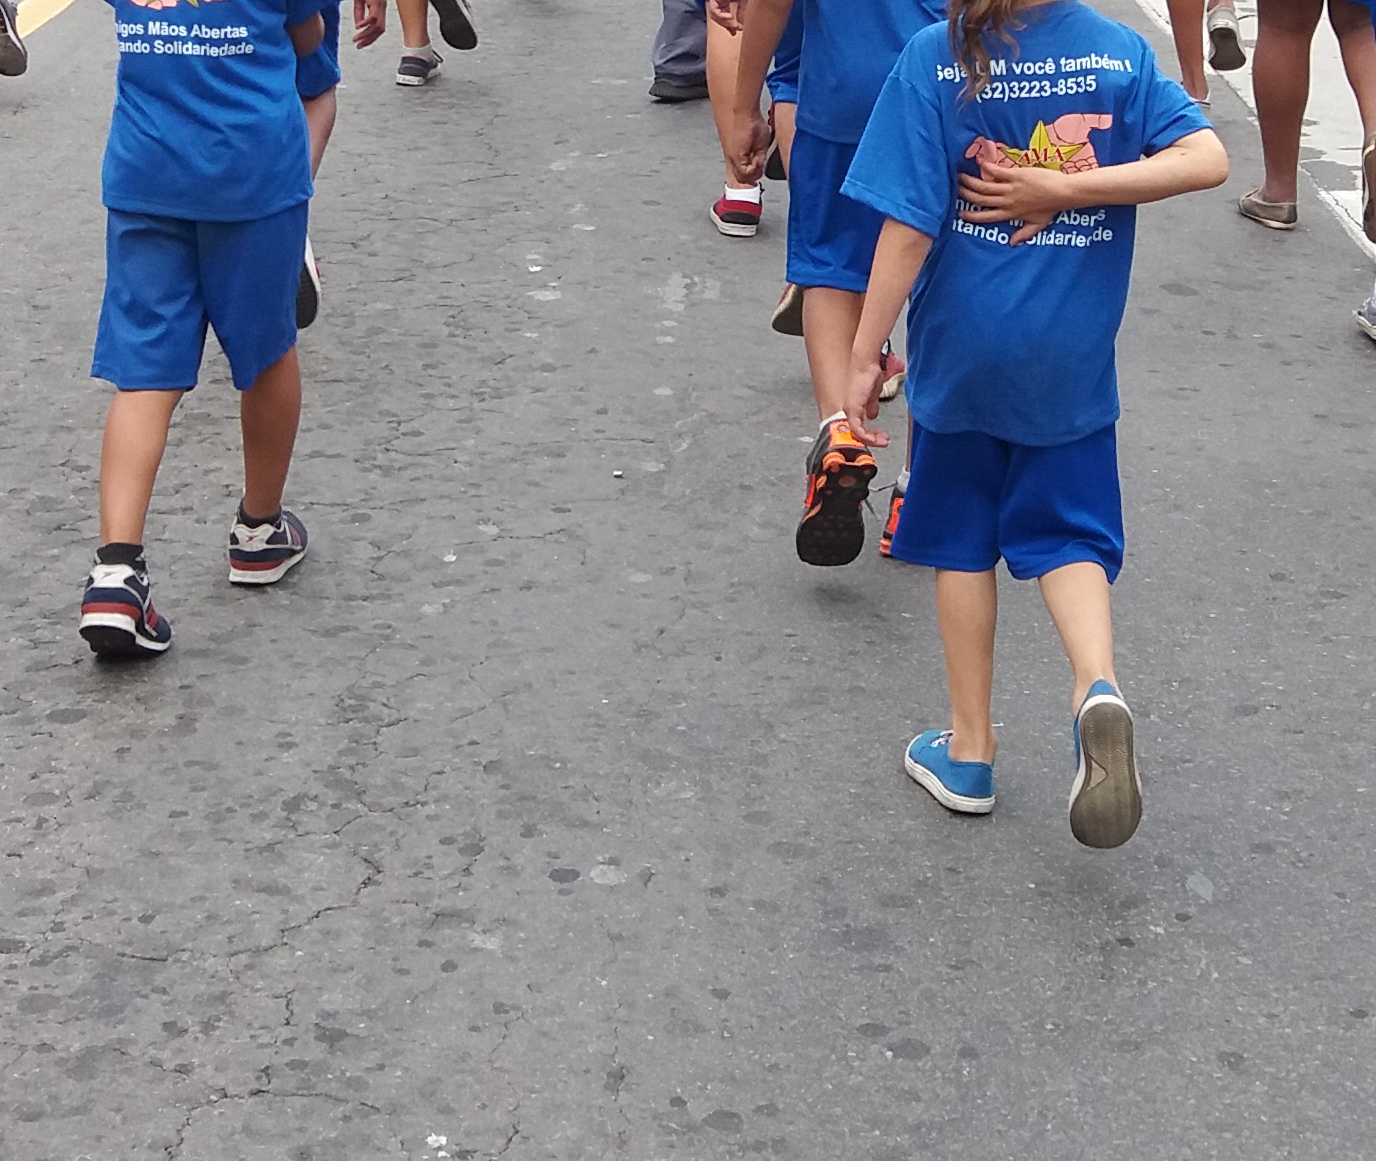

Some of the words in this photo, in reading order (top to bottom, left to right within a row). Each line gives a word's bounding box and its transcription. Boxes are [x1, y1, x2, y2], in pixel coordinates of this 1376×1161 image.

[147, 21, 187, 37] Mãos
[190, 23, 248, 40] Abertas
[153, 39, 254, 57] Solidariedade
[1011, 57, 1056, 77] você
[1059, 52, 1124, 74] também
[976, 74, 1097, 104] (32)3223-8535
[1018, 146, 1065, 166] AMA
